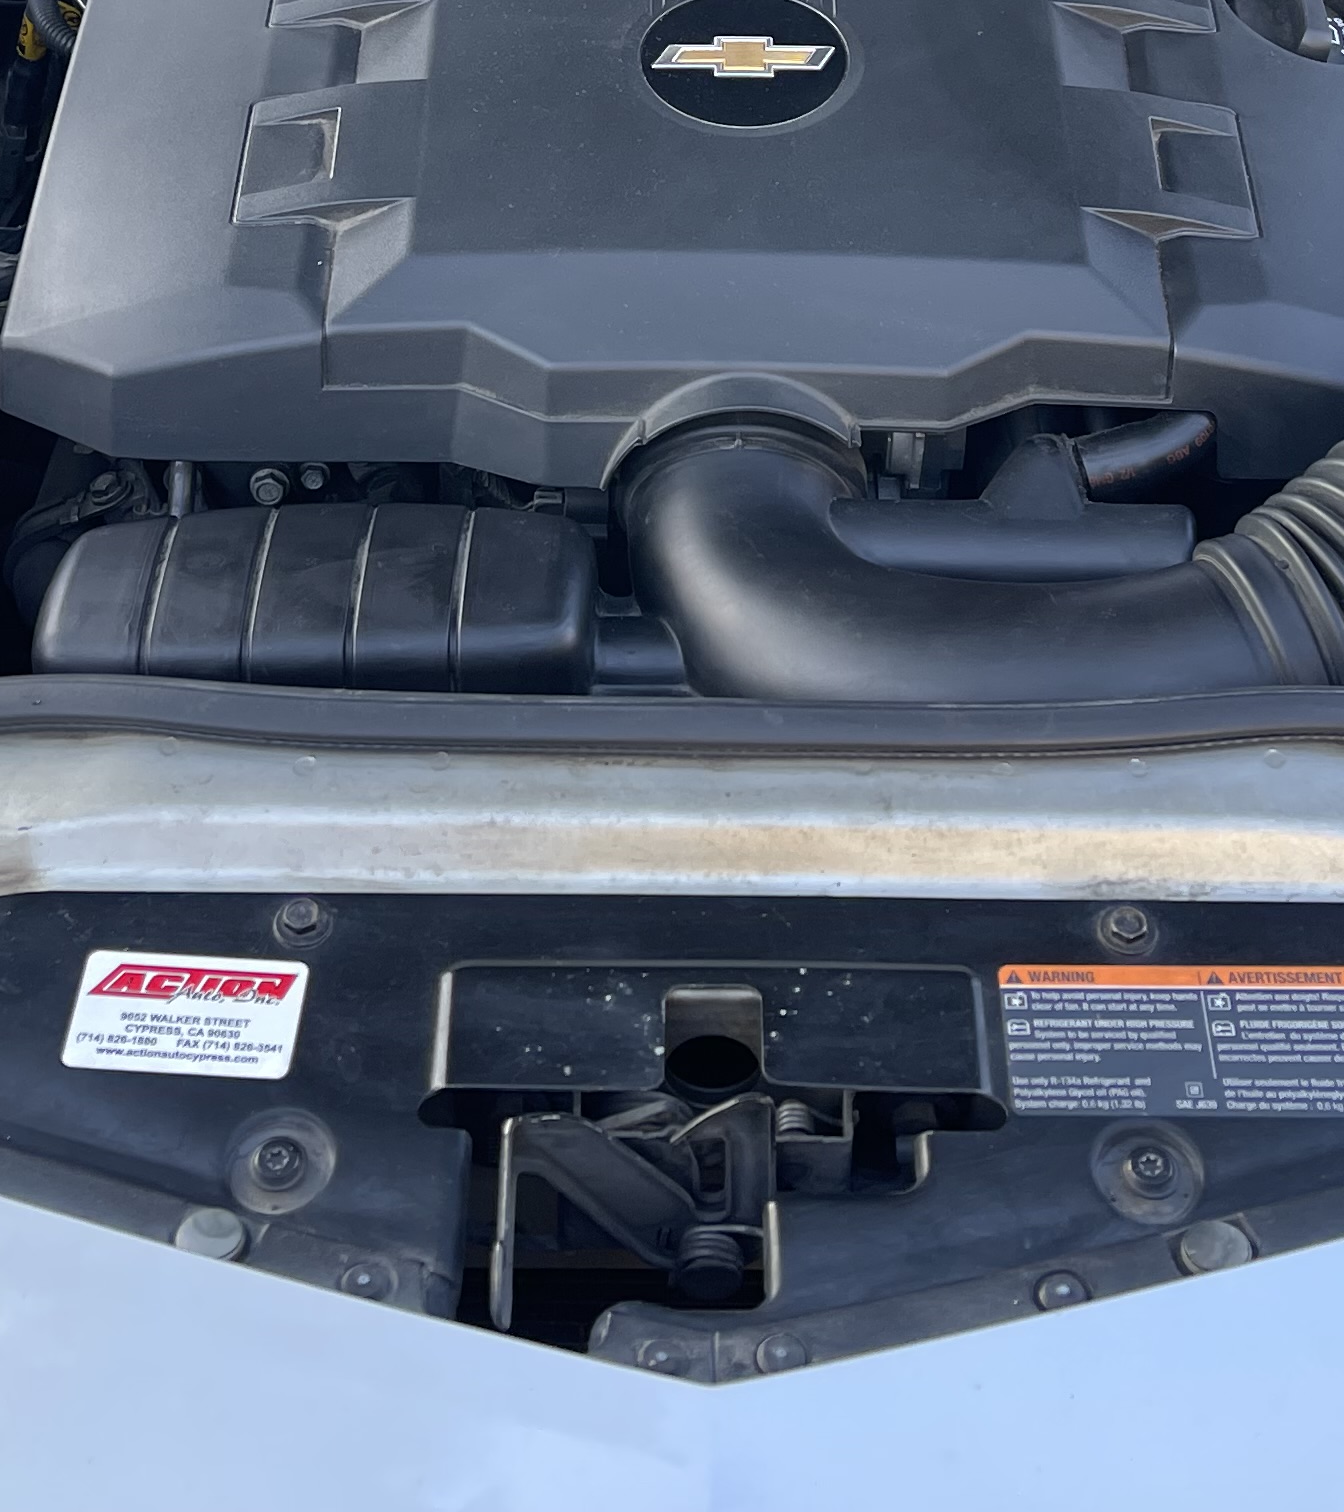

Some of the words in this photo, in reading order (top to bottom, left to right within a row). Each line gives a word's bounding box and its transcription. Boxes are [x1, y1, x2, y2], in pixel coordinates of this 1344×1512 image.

[1027, 971, 1096, 984] WARNING
[1228, 971, 1343, 984] AVERTISSEMENT
[150, 1013, 201, 1026] WALKER
[203, 1016, 252, 1029] STREET
[1033, 1018, 1092, 1029] REFRIGERANT
[1094, 1018, 1125, 1029] UNDER
[1126, 1018, 1148, 1029] HIGH
[1148, 1018, 1195, 1029] PRESSURE
[1239, 1019, 1270, 1029] FLUIDE
[124, 1023, 185, 1037] CYPRESS,
[187, 1027, 205, 1038] CA
[75, 1031, 105, 1045] (714)
[176, 1038, 200, 1049] FAX
[202, 1039, 231, 1053] (714)
[95, 1047, 259, 1065] www.actionautocypress.com
